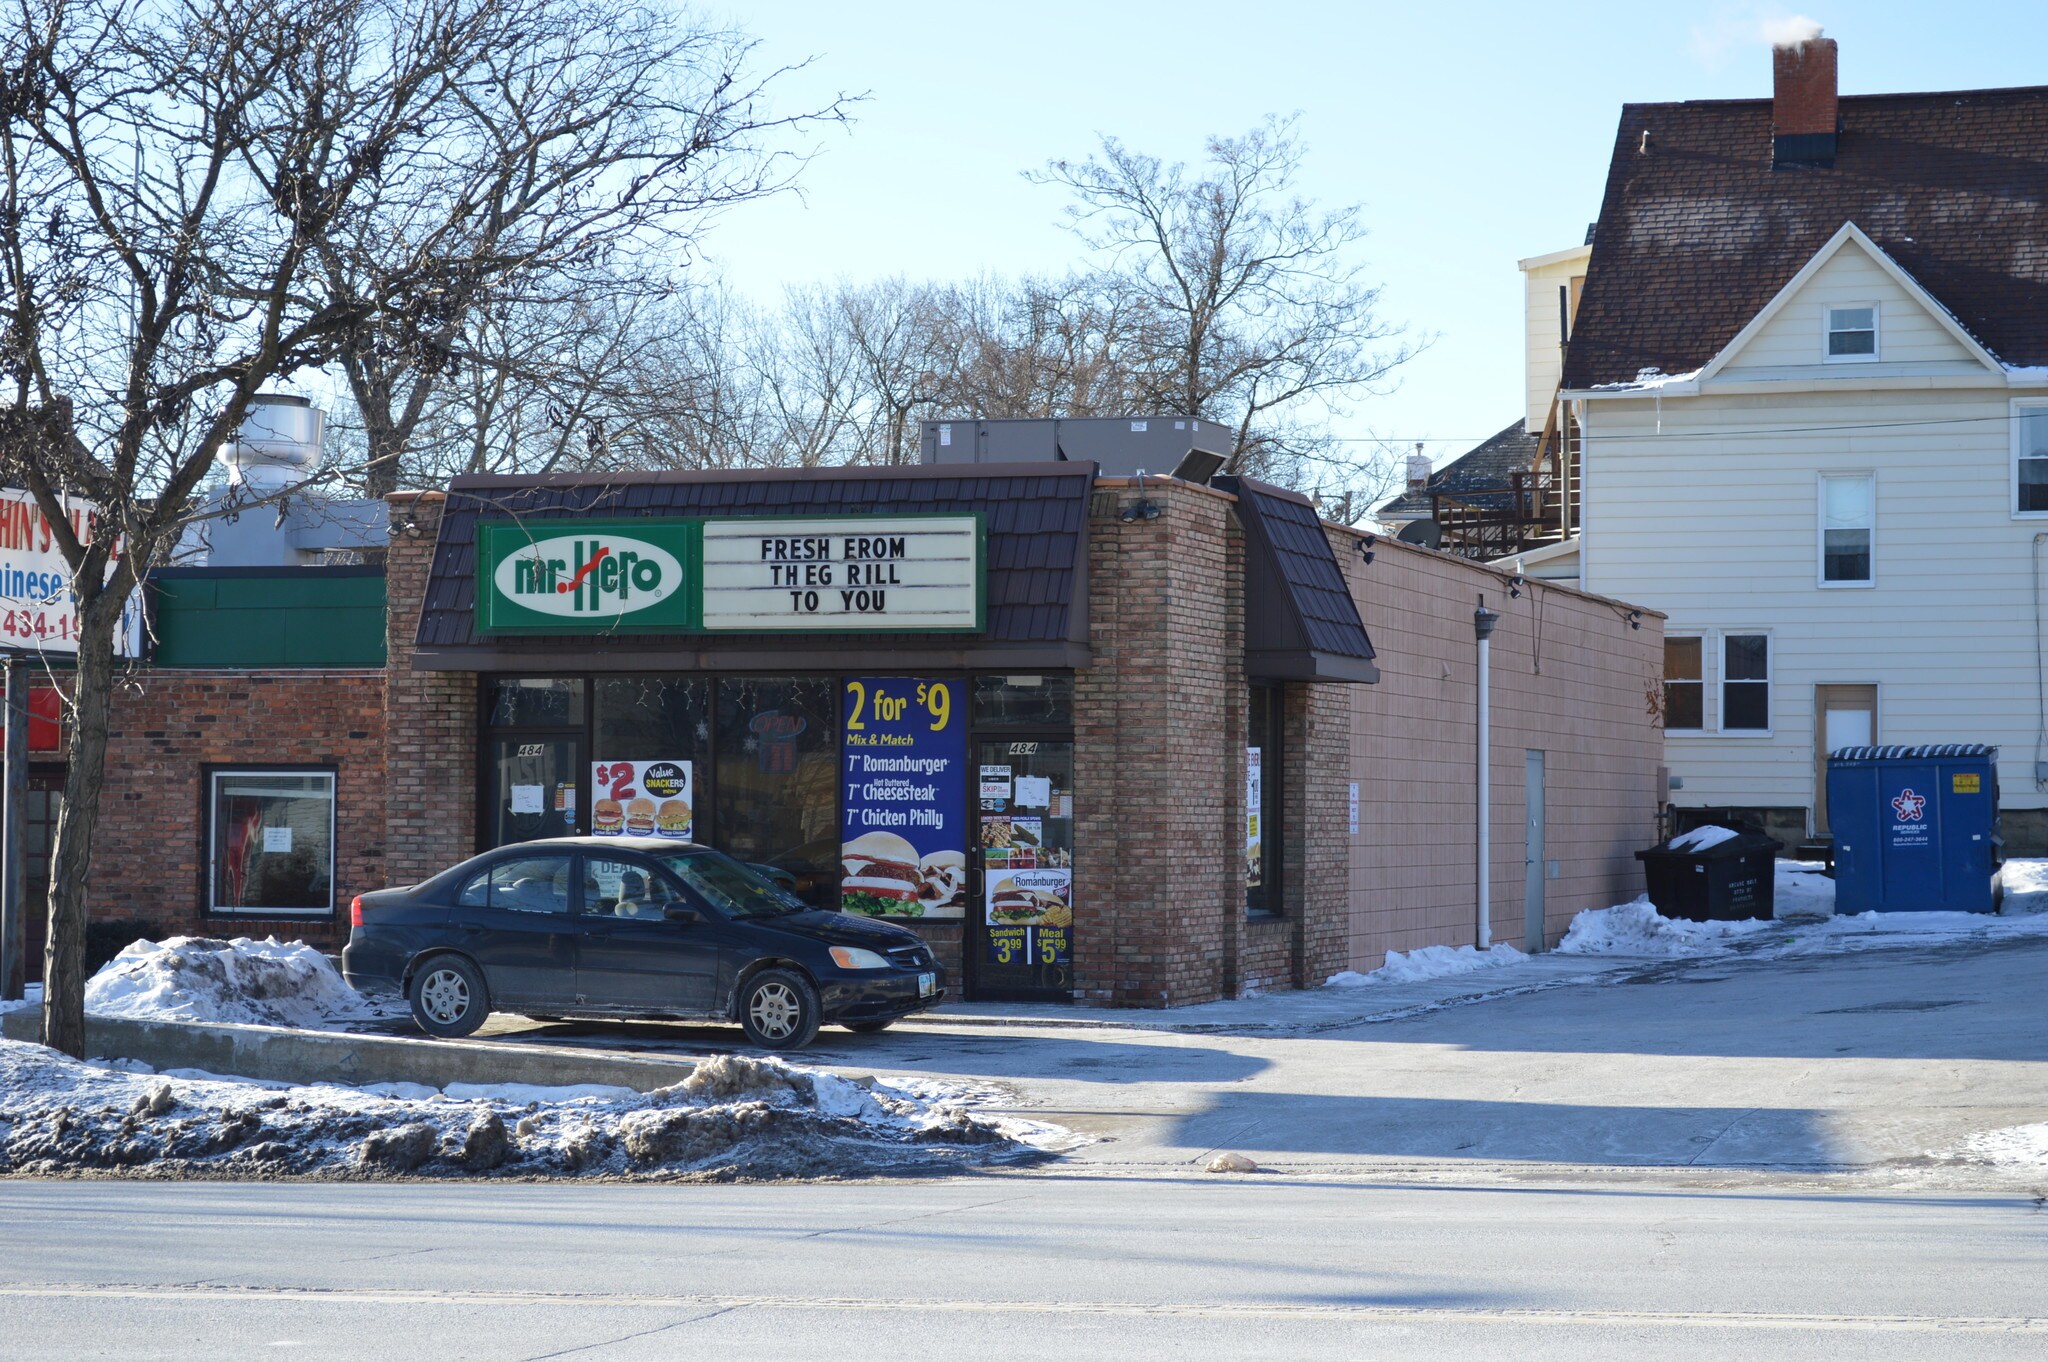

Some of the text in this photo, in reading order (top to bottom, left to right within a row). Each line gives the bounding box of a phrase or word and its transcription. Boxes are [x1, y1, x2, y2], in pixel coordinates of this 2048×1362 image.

[761, 539, 830, 560] FRESH
[573, 540, 662, 611] Hero
[848, 564, 900, 585] RILL
[790, 590, 885, 612] TO YOU
[847, 682, 950, 731] 2 for $9
[754, 716, 800, 733] OPEN
[847, 734, 914, 744] Mix & Match
[520, 746, 542, 755] 484
[1011, 743, 1036, 754] 484
[648, 766, 674, 778] Value
[864, 755, 948, 775] Romanburger
[596, 762, 636, 802] $2
[646, 779, 684, 788] SNACKERS
[863, 784, 936, 801] Cheesesteak
[862, 808, 906, 826] Chicken
[910, 809, 943, 830] Philly
[601, 862, 636, 873] DEAL
[1015, 877, 1066, 888] Romanburger
[990, 928, 1025, 938] Sandwich
[1039, 929, 1063, 938] Meal
